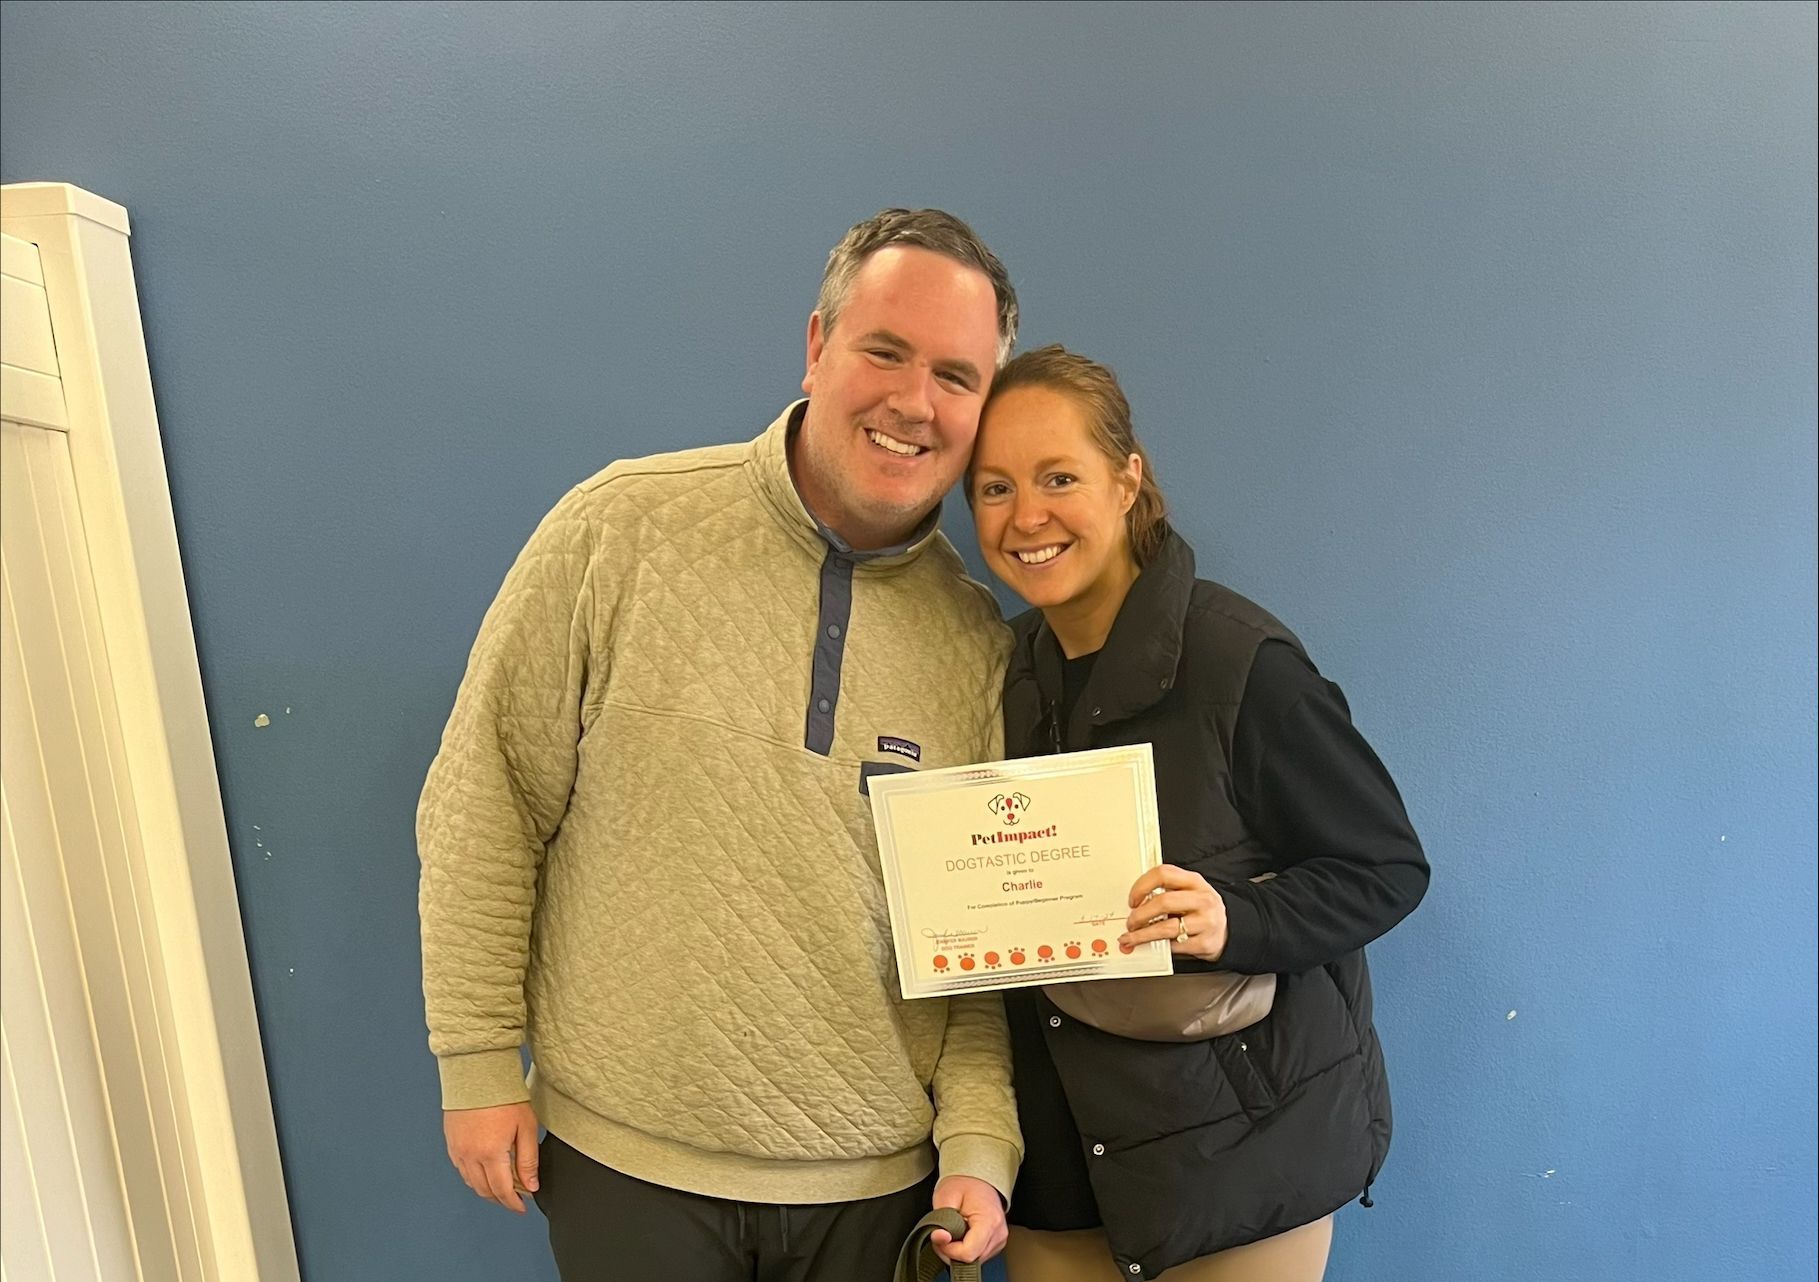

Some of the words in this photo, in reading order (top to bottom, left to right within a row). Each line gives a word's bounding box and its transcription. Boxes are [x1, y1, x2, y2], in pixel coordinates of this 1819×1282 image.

[971, 825, 1057, 846] PetImpact!
[945, 852, 1026, 872] DOGTASTIC
[1030, 845, 1091, 863] DEGREE
[1002, 879, 1043, 892] Charlie
